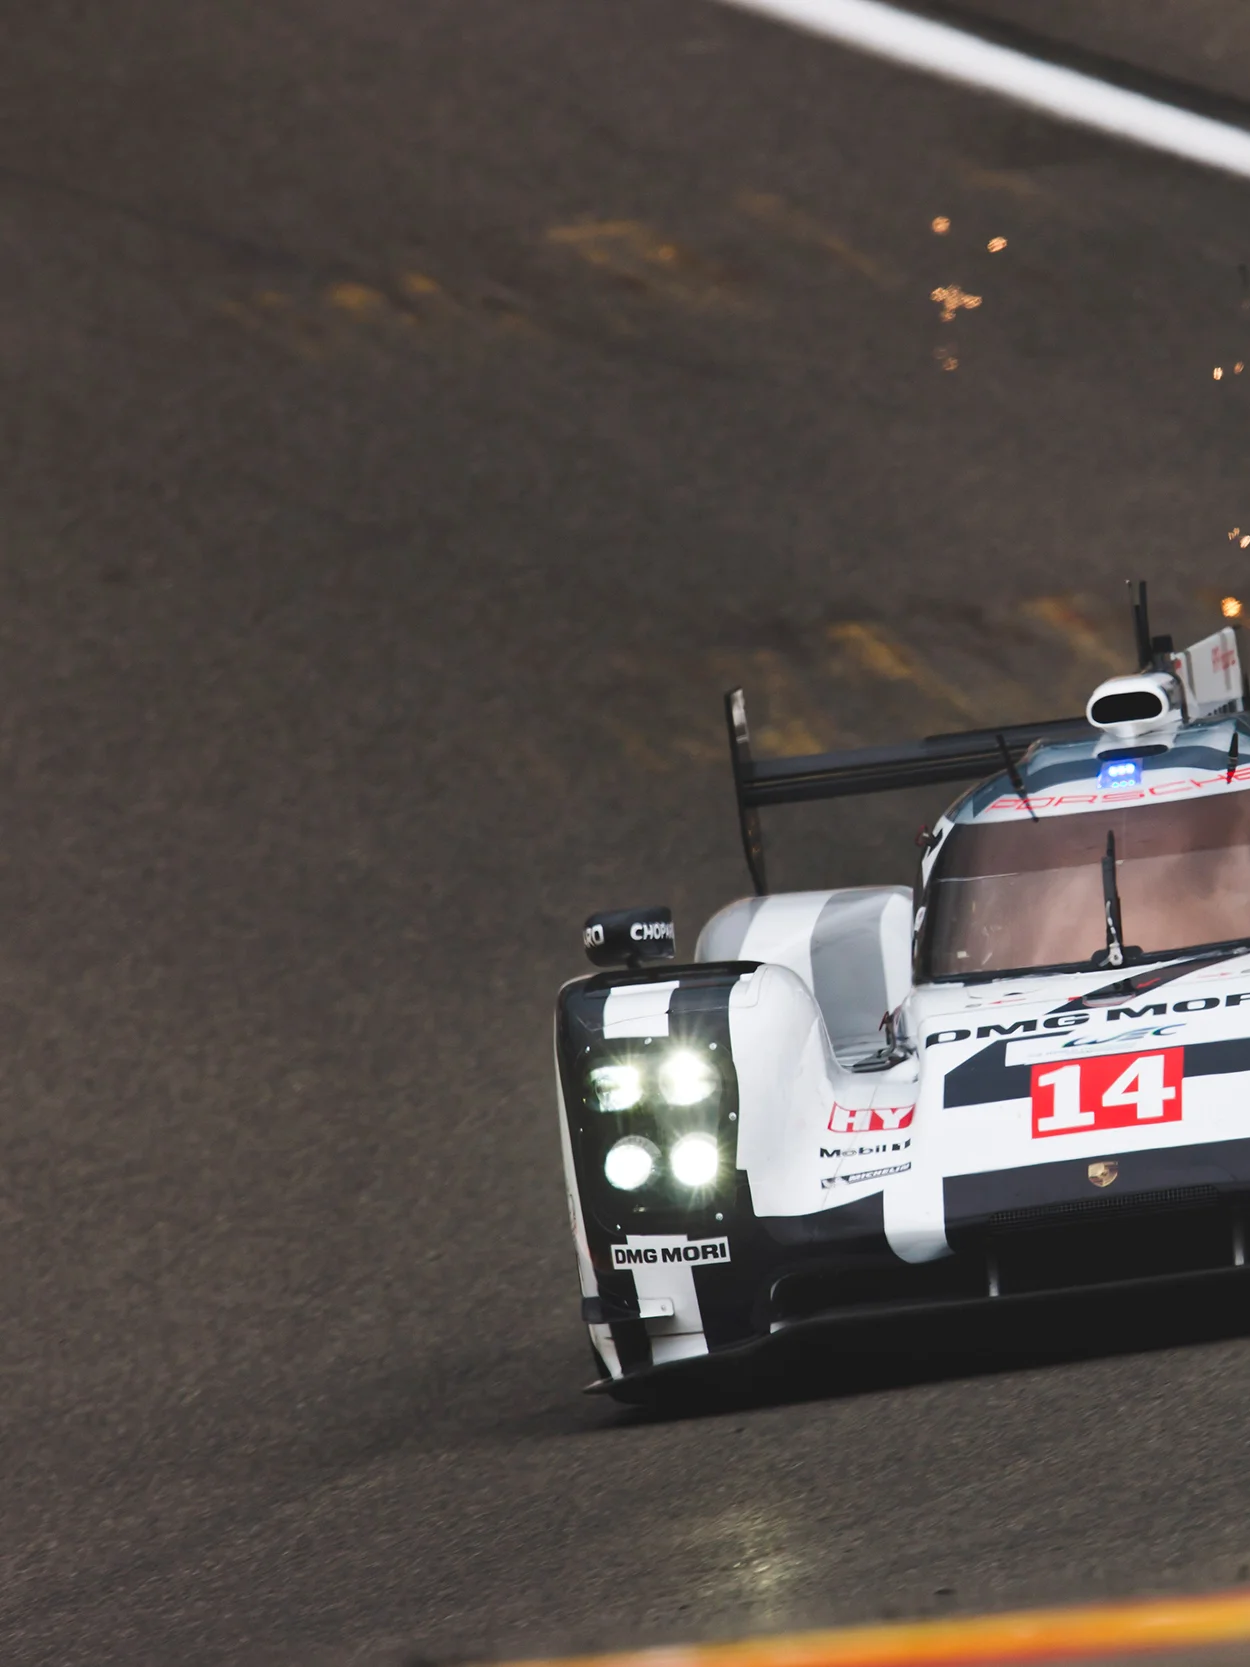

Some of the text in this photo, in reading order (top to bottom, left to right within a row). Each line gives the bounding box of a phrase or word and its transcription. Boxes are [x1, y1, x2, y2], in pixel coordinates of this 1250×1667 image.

[925, 1013, 1090, 1048] DMG
[1038, 1054, 1176, 1132] 14
[828, 1104, 914, 1132] HY
[820, 1144, 886, 1158] Mobil
[848, 1163, 911, 1183] MICHELIN
[614, 1243, 727, 1264] DMG MORI
